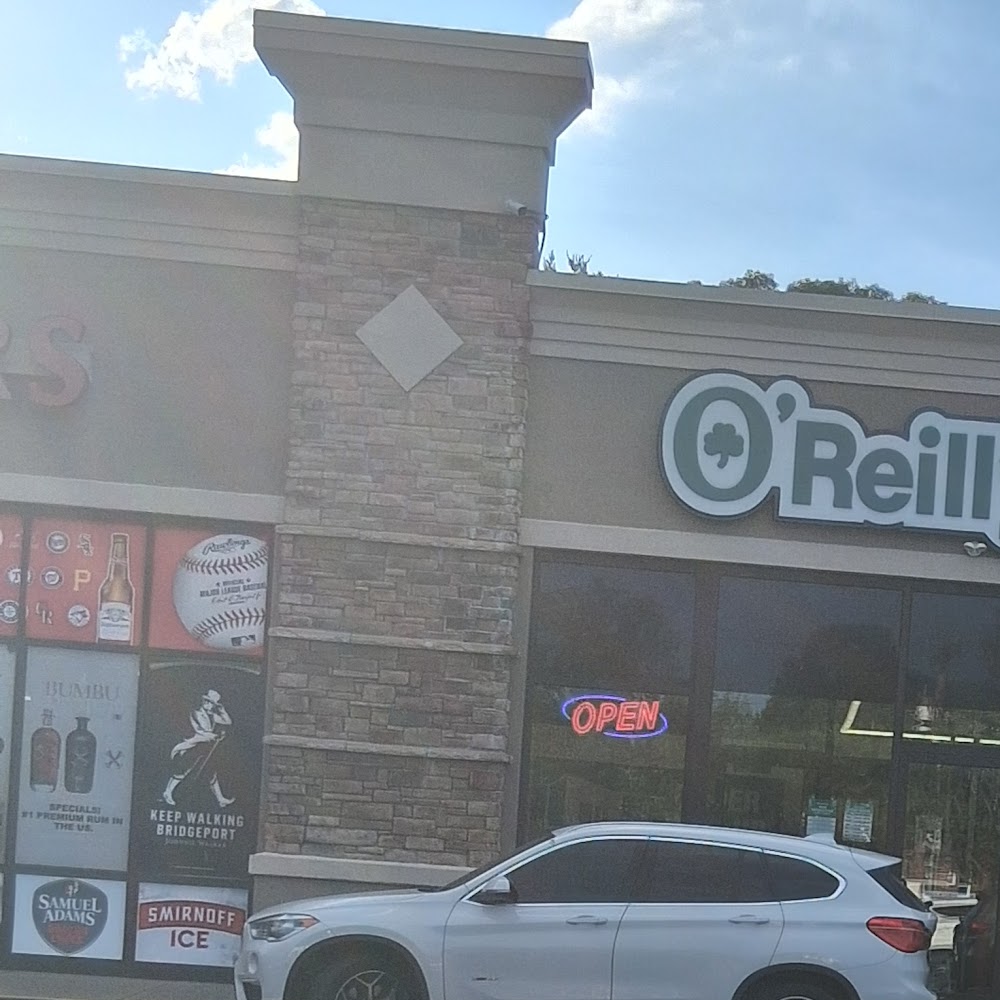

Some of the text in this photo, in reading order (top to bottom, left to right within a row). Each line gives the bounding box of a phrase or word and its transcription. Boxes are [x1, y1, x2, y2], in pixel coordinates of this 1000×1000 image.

[571, 701, 660, 735] OPEN
[37, 811, 84, 823] PREMIUM
[87, 815, 109, 824] RUM
[112, 817, 123, 825] IN
[54, 822, 74, 831] THE
[150, 809, 245, 828] KEEP WALKING
[156, 824, 237, 840] BRIDGEPORT
[38, 894, 102, 913] SAMUEL
[43, 908, 95, 926] ADAMS
[148, 906, 236, 927] SMIRNOFF
[170, 929, 209, 949] ICE
